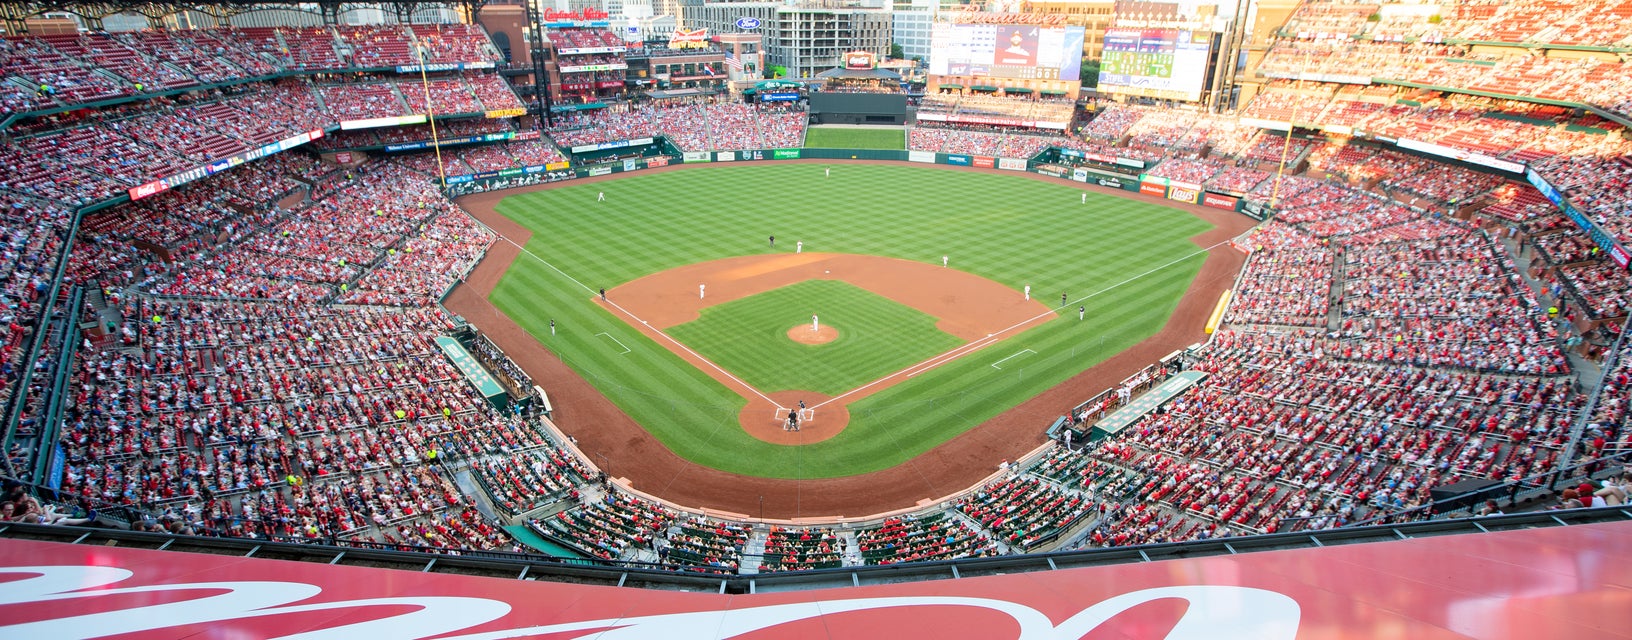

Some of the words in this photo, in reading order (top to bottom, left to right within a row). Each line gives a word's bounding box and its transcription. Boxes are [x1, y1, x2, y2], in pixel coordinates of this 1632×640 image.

[544, 8, 580, 22] Cardinals
[581, 7, 608, 21] Nation
[957, 4, 1066, 24] Budweiser
[741, 18, 757, 28] Ford
